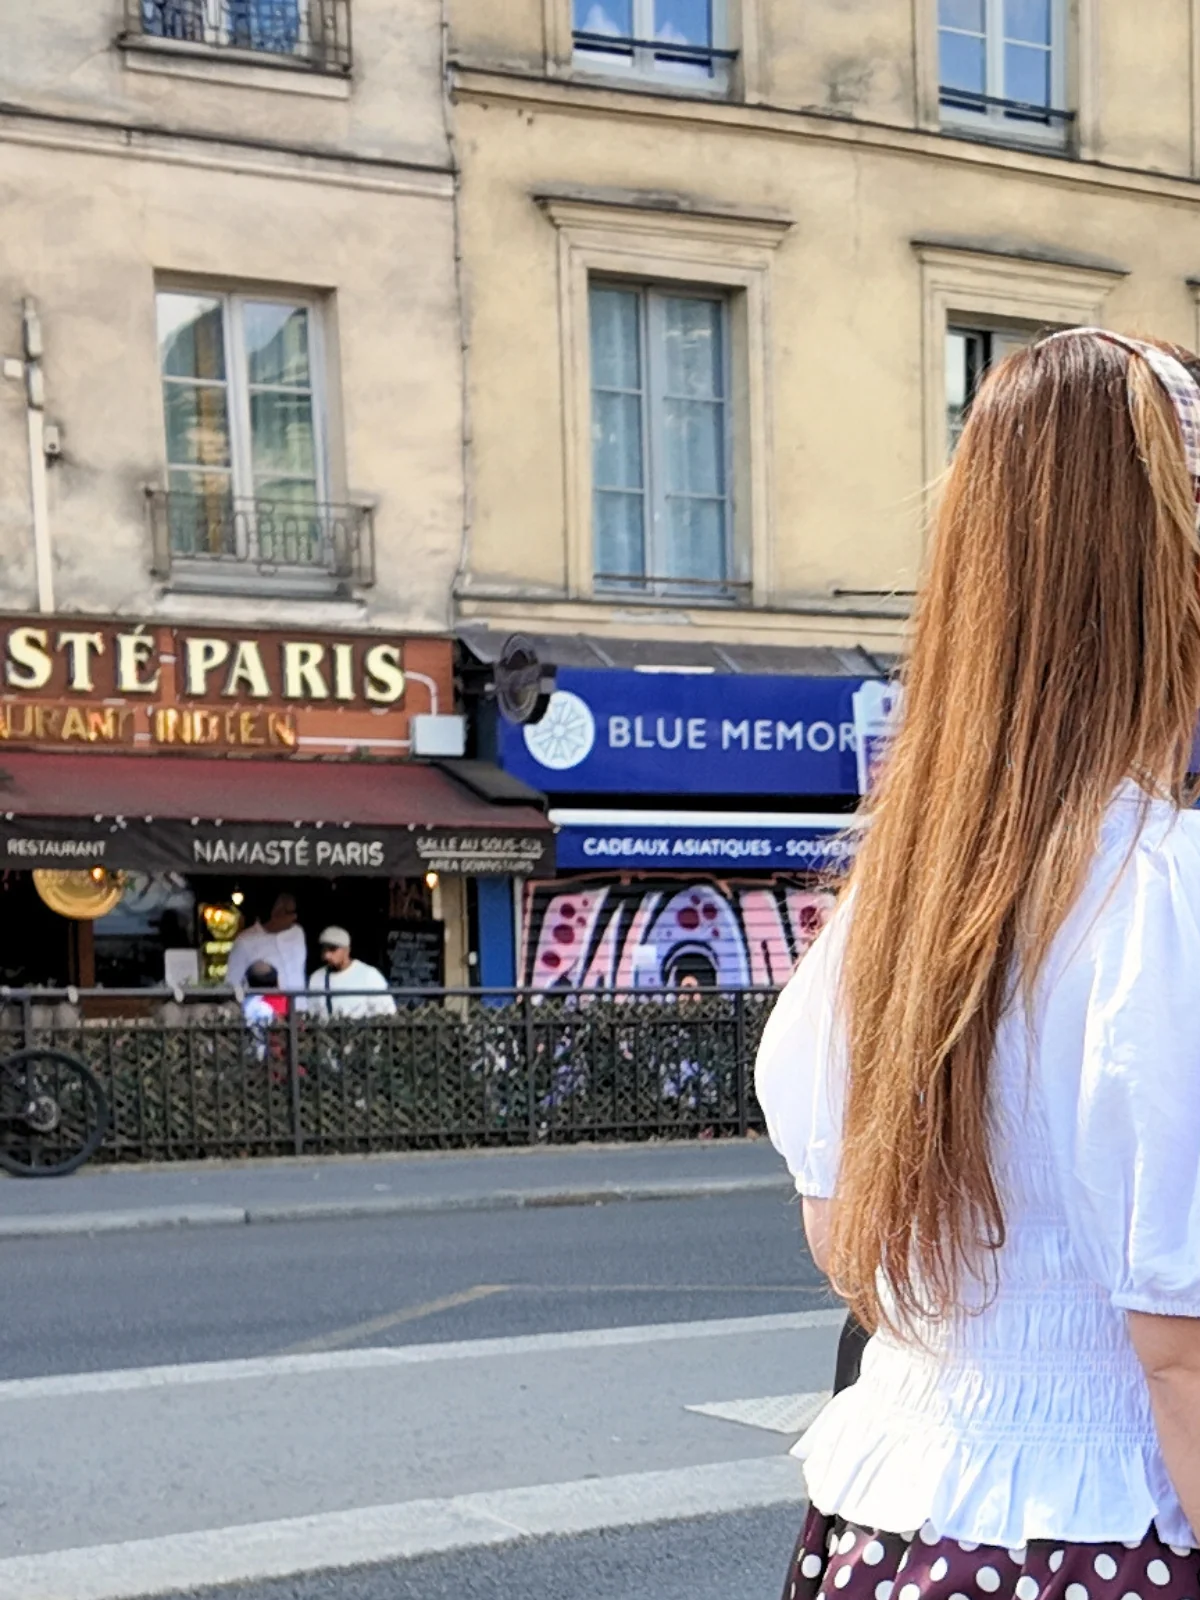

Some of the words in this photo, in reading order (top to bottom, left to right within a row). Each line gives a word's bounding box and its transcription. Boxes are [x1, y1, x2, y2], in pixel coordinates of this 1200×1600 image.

[183, 637, 406, 703] PARIS
[608, 715, 707, 750] BLUE
[7, 838, 106, 857] RESTAURANT
[193, 836, 311, 866] NAMASTÉ
[315, 840, 385, 867] PARIS
[583, 837, 669, 856] CADEAUX
[672, 838, 771, 859] ASIATIQUES
